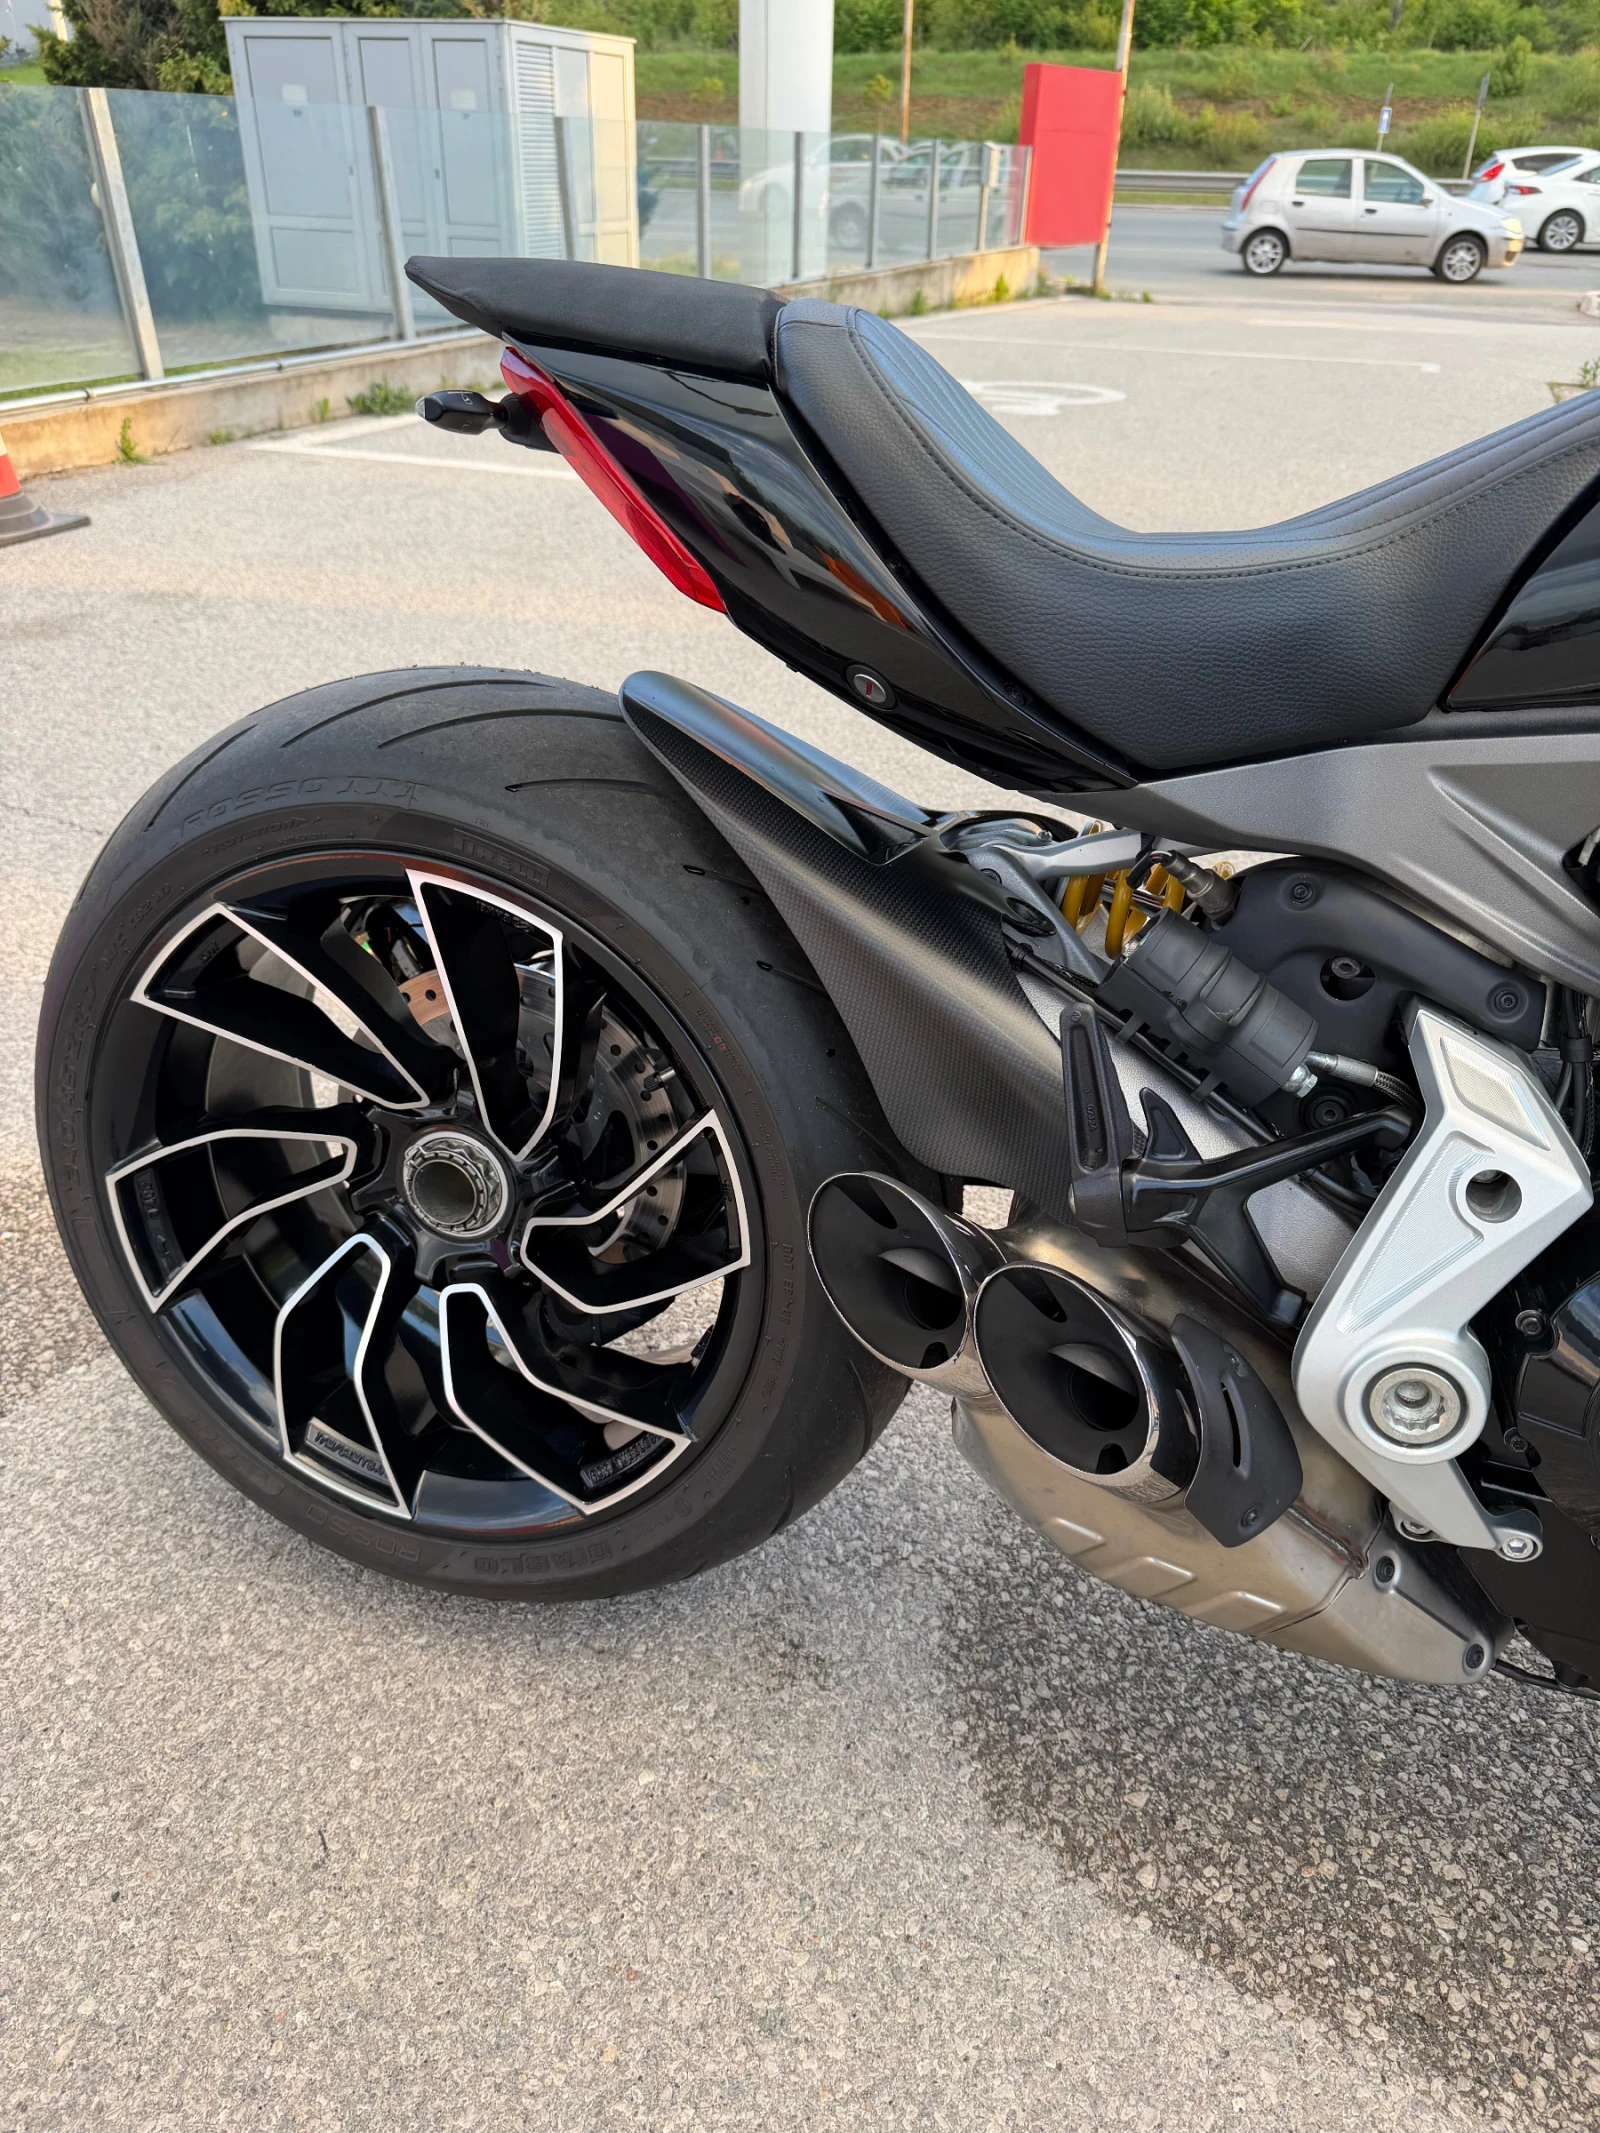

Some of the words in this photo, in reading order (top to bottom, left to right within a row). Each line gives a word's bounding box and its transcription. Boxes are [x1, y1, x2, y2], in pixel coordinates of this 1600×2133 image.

[178, 777, 329, 837] ROSSO
[207, 816, 300, 855] ROTATION
[452, 827, 553, 889] PIRELLI
[782, 1243, 794, 1272] DOT
[304, 1502, 422, 1564] ROSSO
[473, 1540, 614, 1575] DIABLO
